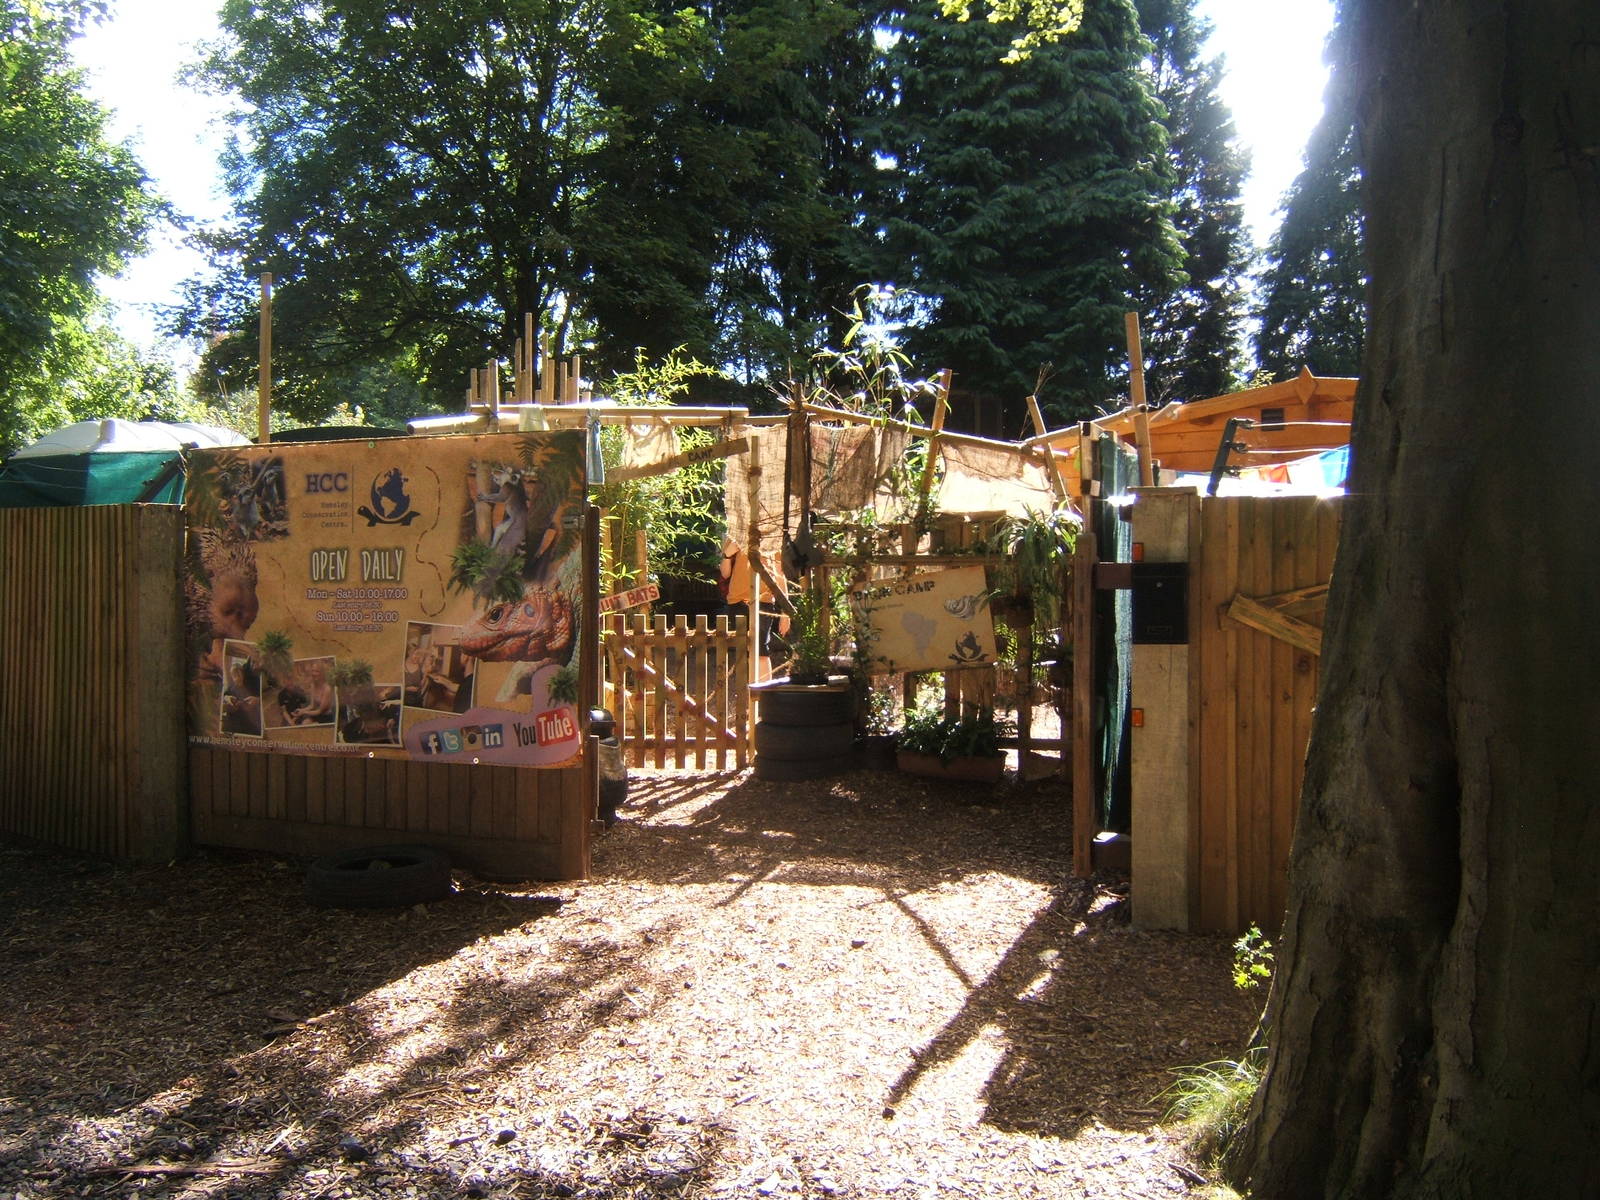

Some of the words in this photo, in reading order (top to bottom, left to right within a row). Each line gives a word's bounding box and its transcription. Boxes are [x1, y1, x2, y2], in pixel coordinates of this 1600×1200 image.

[688, 449, 712, 461] CAMP
[305, 473, 348, 492] HCC
[312, 550, 347, 580] OPEN
[362, 550, 403, 581] DAILY
[307, 588, 328, 599] Mon
[336, 588, 353, 599] Sat
[895, 581, 935, 595] CAMP
[627, 586, 658, 605] BATS
[316, 611, 335, 621] Sun
[337, 611, 363, 621] 10.00
